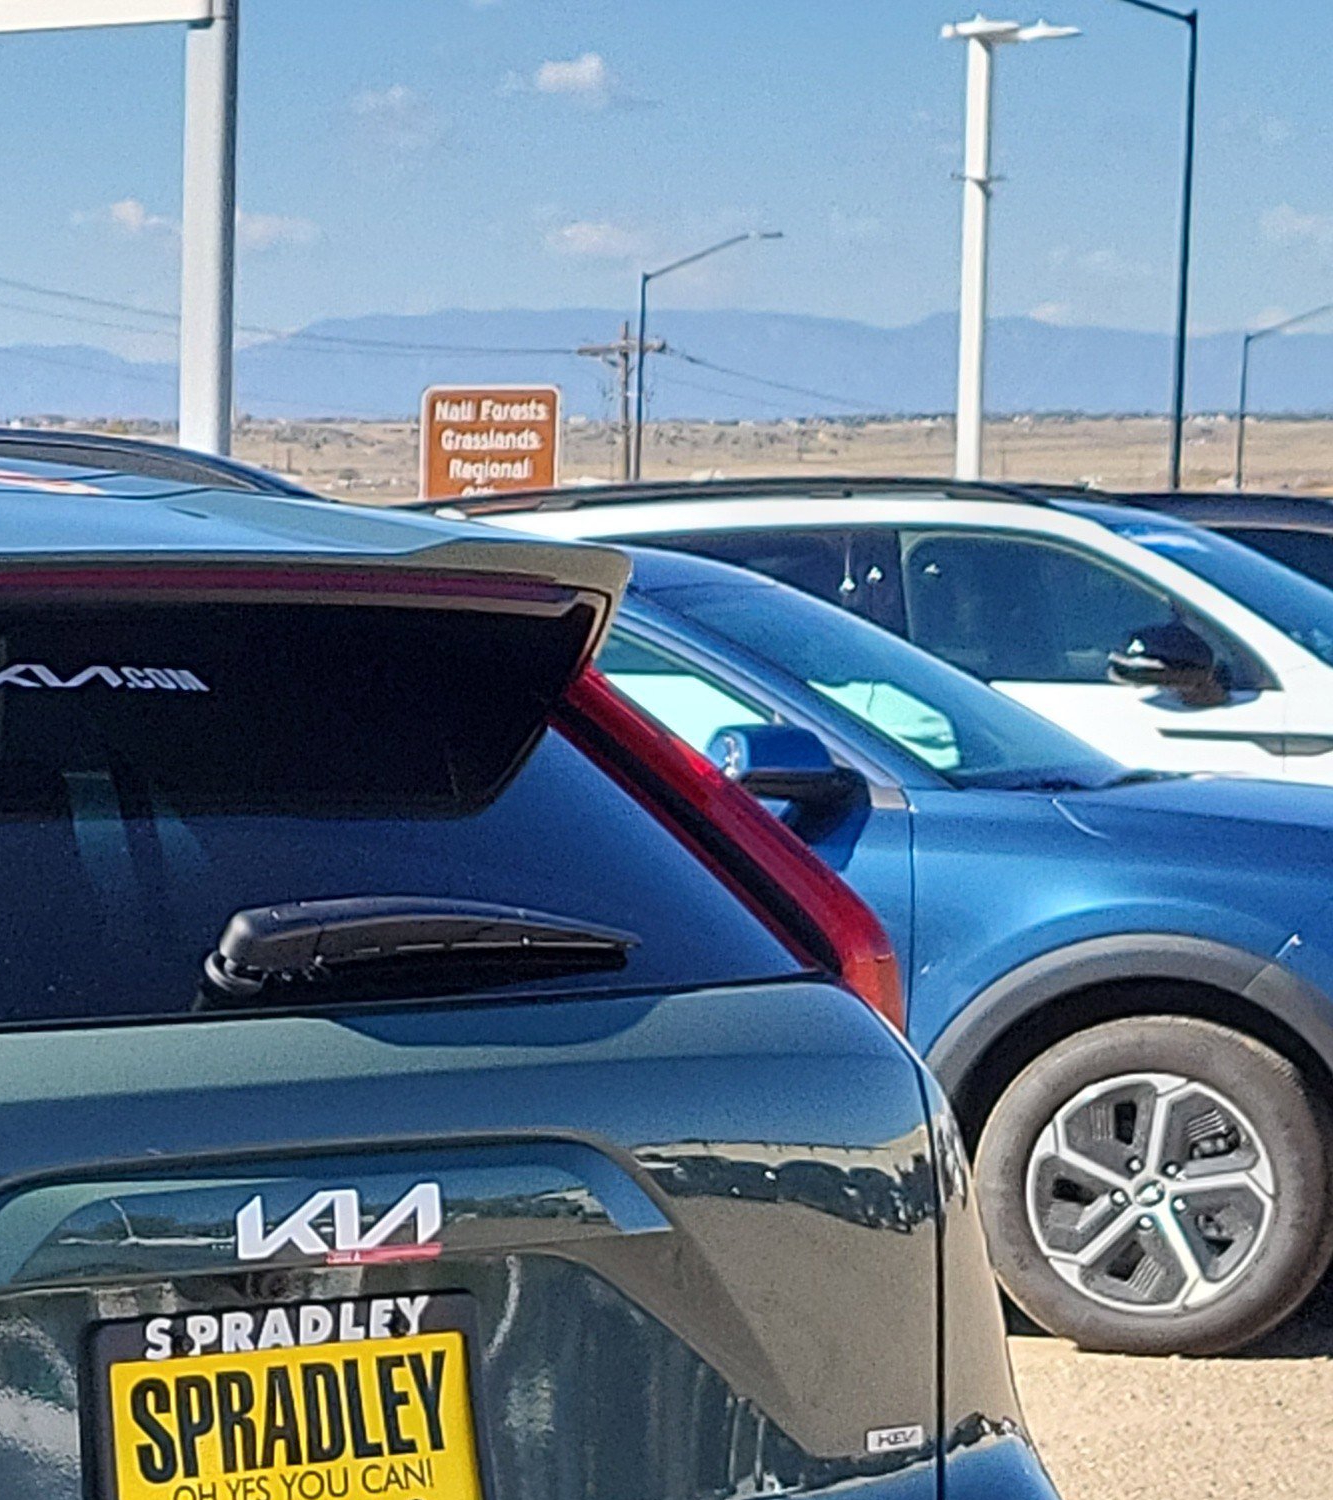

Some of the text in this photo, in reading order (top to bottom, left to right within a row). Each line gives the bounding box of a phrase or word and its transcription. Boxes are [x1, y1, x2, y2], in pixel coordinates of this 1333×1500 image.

[480, 399, 550, 421] Forests
[441, 428, 544, 451] Grasslands
[448, 456, 533, 484] Regional
[236, 1183, 441, 1261] KIA
[131, 1349, 448, 1484] SPRADLEY
[361, 1458, 435, 1495] CAN!
